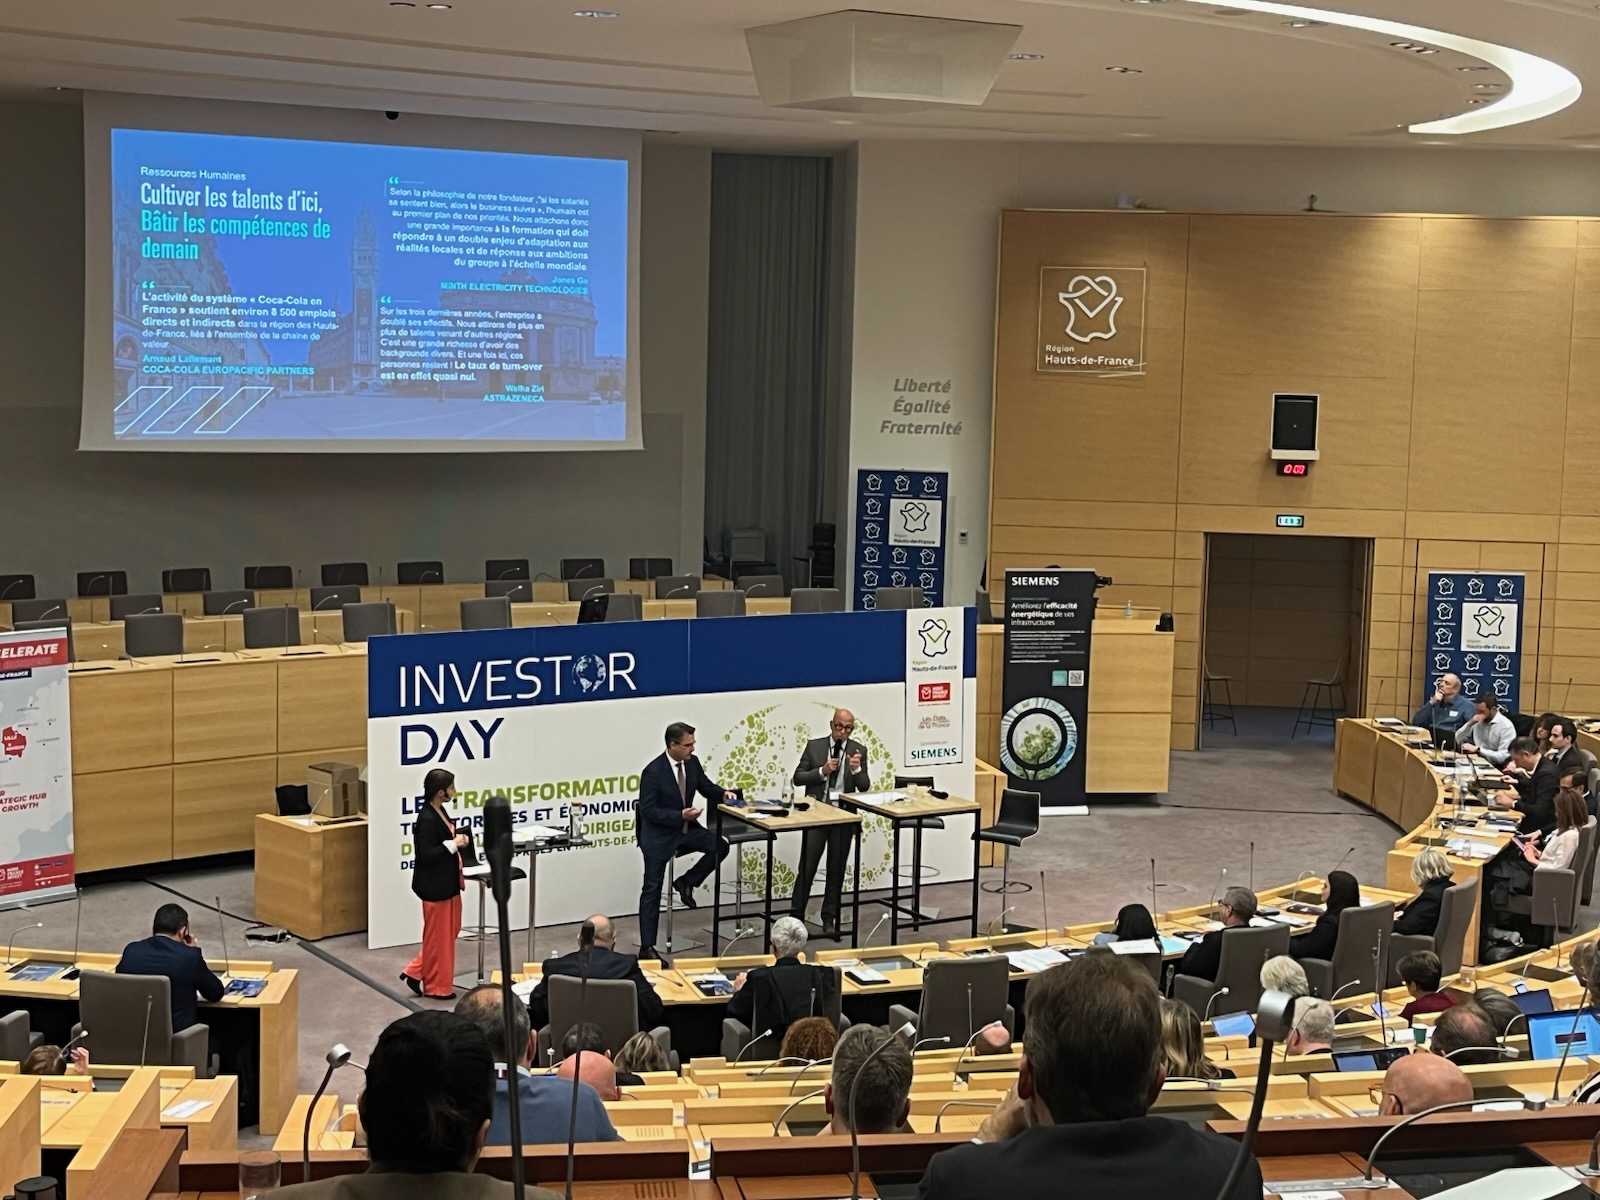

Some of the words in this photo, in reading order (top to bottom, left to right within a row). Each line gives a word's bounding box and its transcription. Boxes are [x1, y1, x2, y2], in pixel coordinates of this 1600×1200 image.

[141, 167, 196, 178] Ressources
[200, 170, 246, 181] Humaines
[141, 183, 200, 206] Cultiver
[205, 186, 227, 208] les
[232, 188, 282, 210] talents
[141, 210, 178, 233] Bâtir
[184, 211, 205, 233] les
[210, 215, 307, 240] compétences
[313, 218, 330, 239] de
[512, 226, 554, 235] formation
[572, 229, 588, 237] doit
[393, 232, 434, 241] répondre
[458, 234, 488, 243] double
[491, 236, 515, 246] enjeu
[142, 238, 198, 259] demain
[432, 245, 463, 254] locales
[546, 250, 588, 259] ambitions
[470, 283, 522, 292] ELECTRICITY
[524, 284, 588, 294] TECHNOLOGIES
[206, 294, 247, 304] système
[258, 296, 308, 305] Coca-Cola
[143, 305, 177, 313] France
[189, 306, 229, 314] soutient
[299, 310, 336, 318] emplois
[143, 317, 177, 326] directs
[193, 318, 235, 327] indirects
[1046, 345, 1074, 353] Région
[1045, 355, 1134, 366] Hauts-de-France
[202, 366, 264, 374] EUROPACIFIC
[893, 379, 951, 393] Liberté
[893, 396, 951, 415] Égalité
[880, 420, 962, 435] Fraternité
[1012, 576, 1060, 586] SIEMENS
[0, 644, 58, 659] ELERATE
[400, 718, 505, 766] DAY
[911, 748, 957, 759] SIEMENS
[0, 795, 27, 804] ATEGIC
[402, 796, 426, 815] LE
[452, 775, 640, 809] TRANSFORMATIO
[2, 802, 39, 812] GROWTH
[535, 808, 553, 821] ET
[560, 800, 637, 819] ÉONOMI
